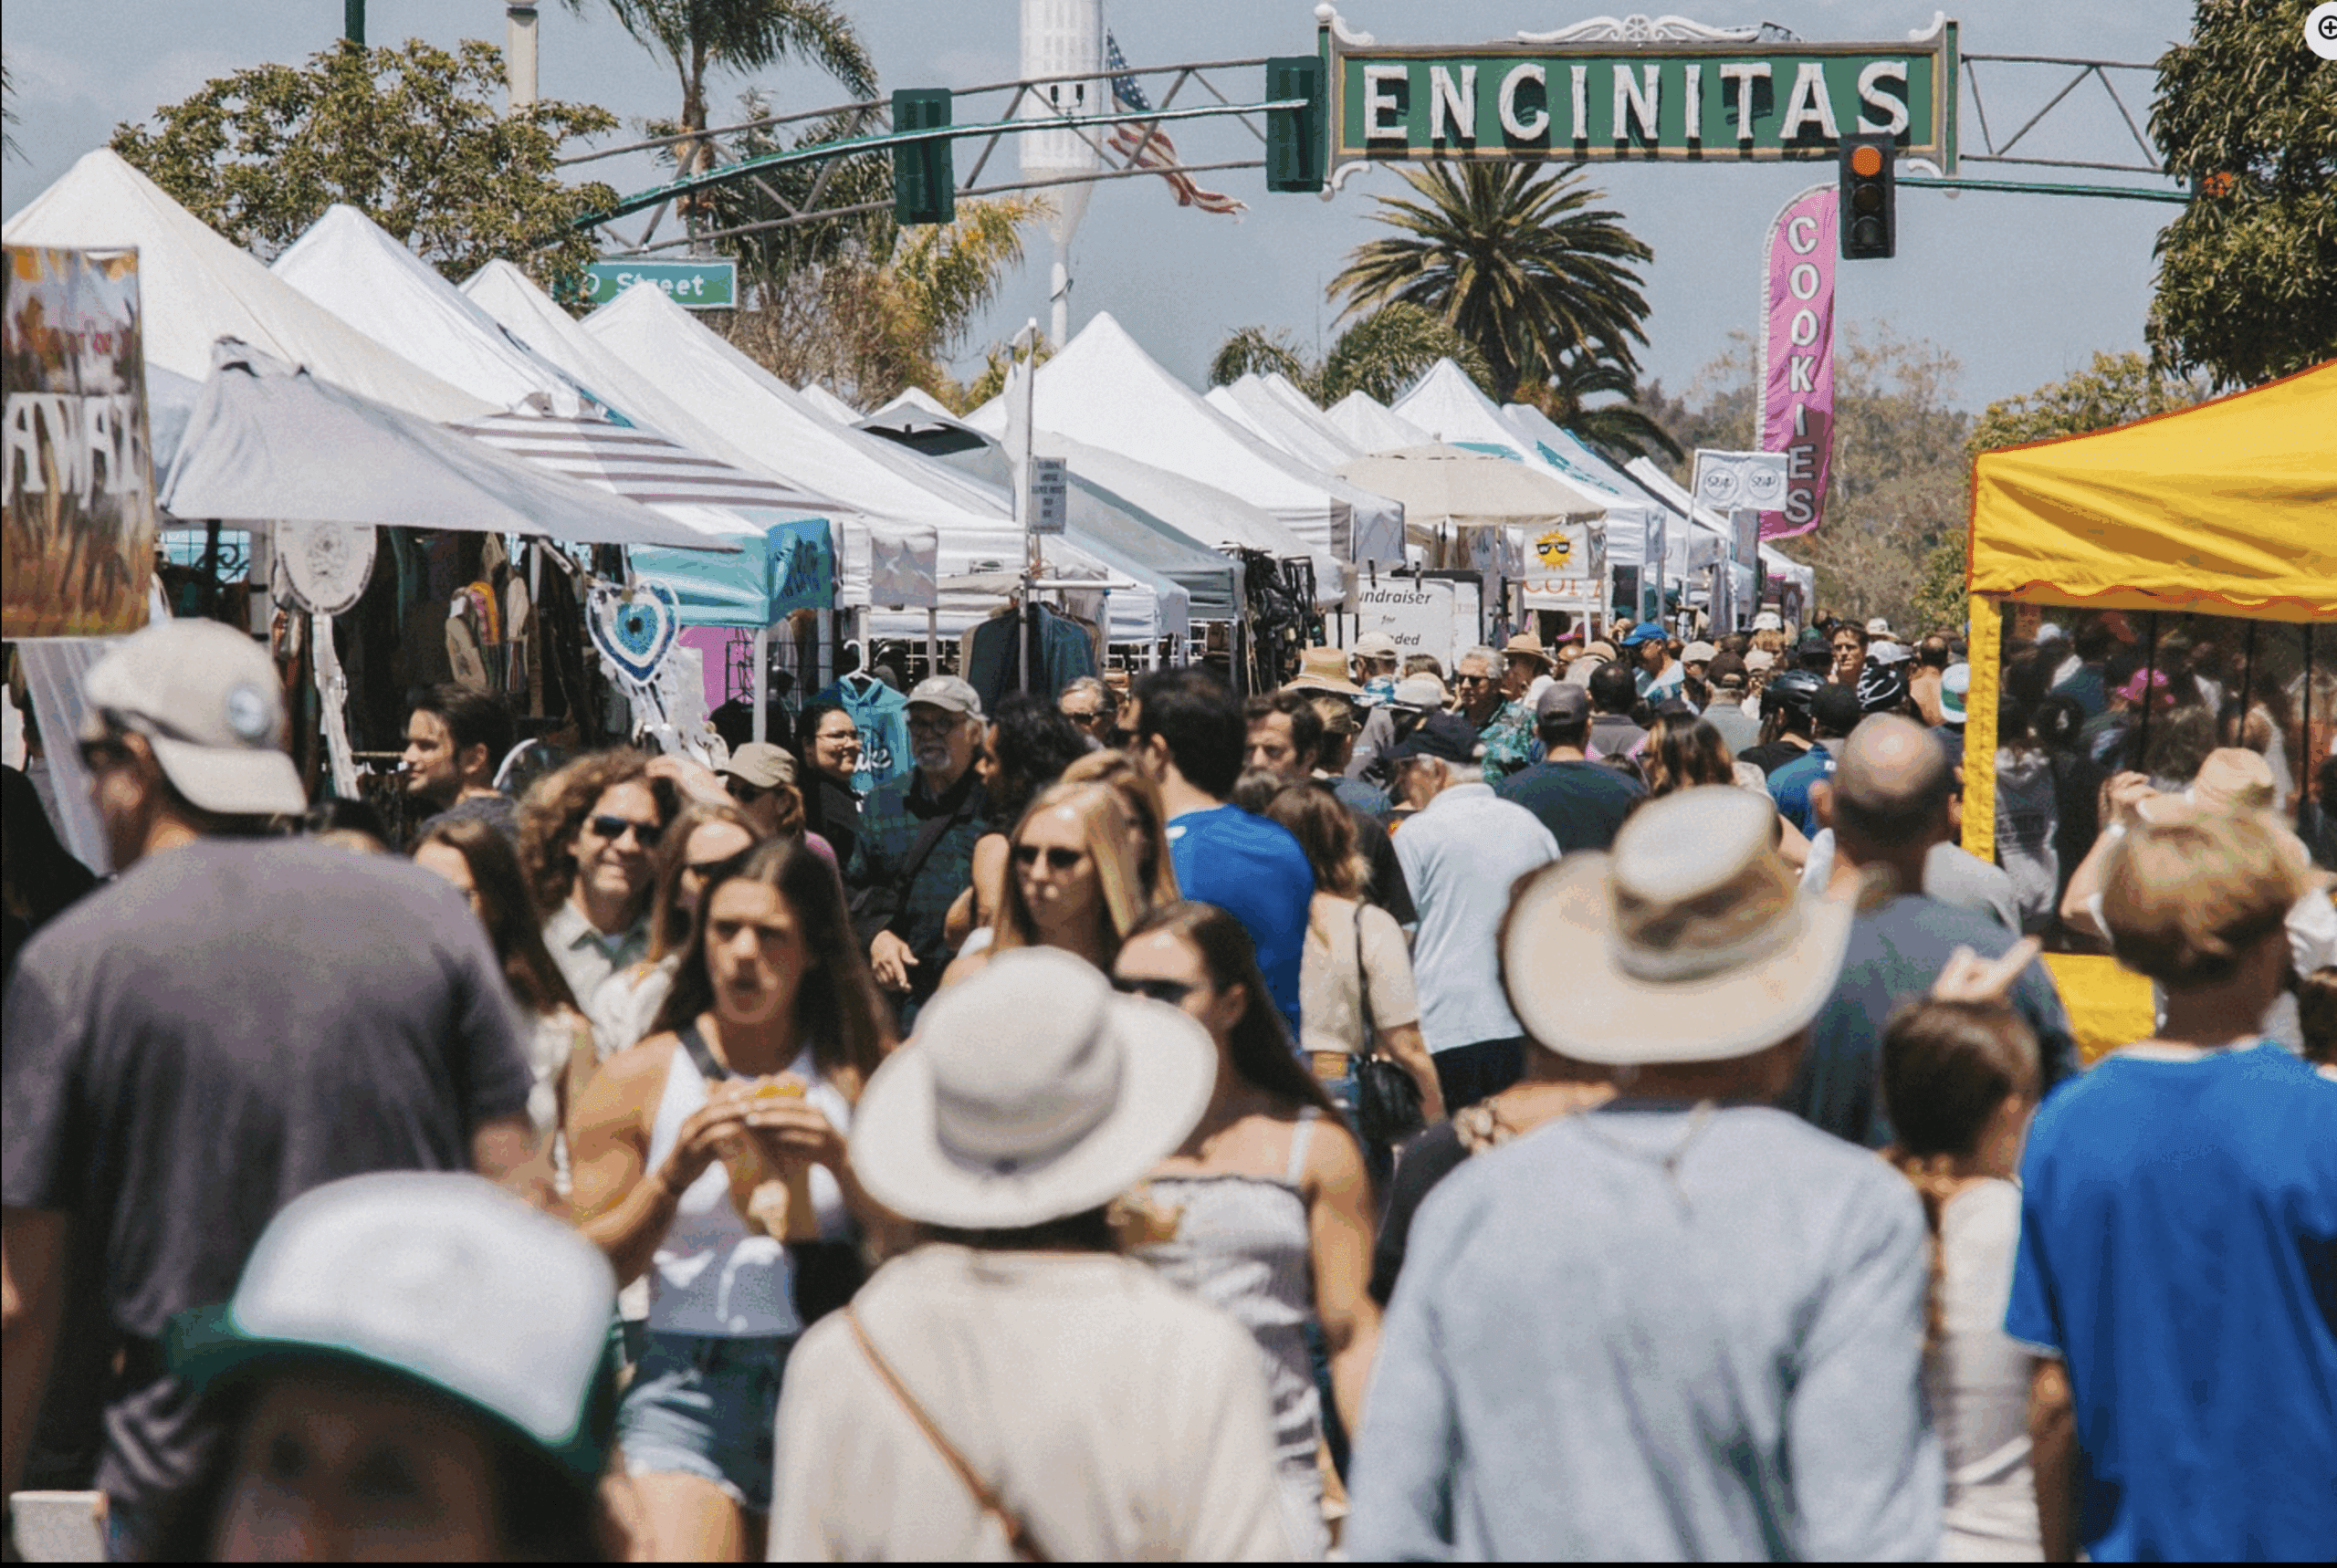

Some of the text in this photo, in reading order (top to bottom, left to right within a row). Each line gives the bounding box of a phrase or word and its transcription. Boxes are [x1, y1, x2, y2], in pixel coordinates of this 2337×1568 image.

[1363, 61, 1911, 141] ENCINITAS
[616, 273, 705, 297] Seet
[1785, 214, 1822, 526] COOKIES
[1358, 589, 1432, 604] undraiser
